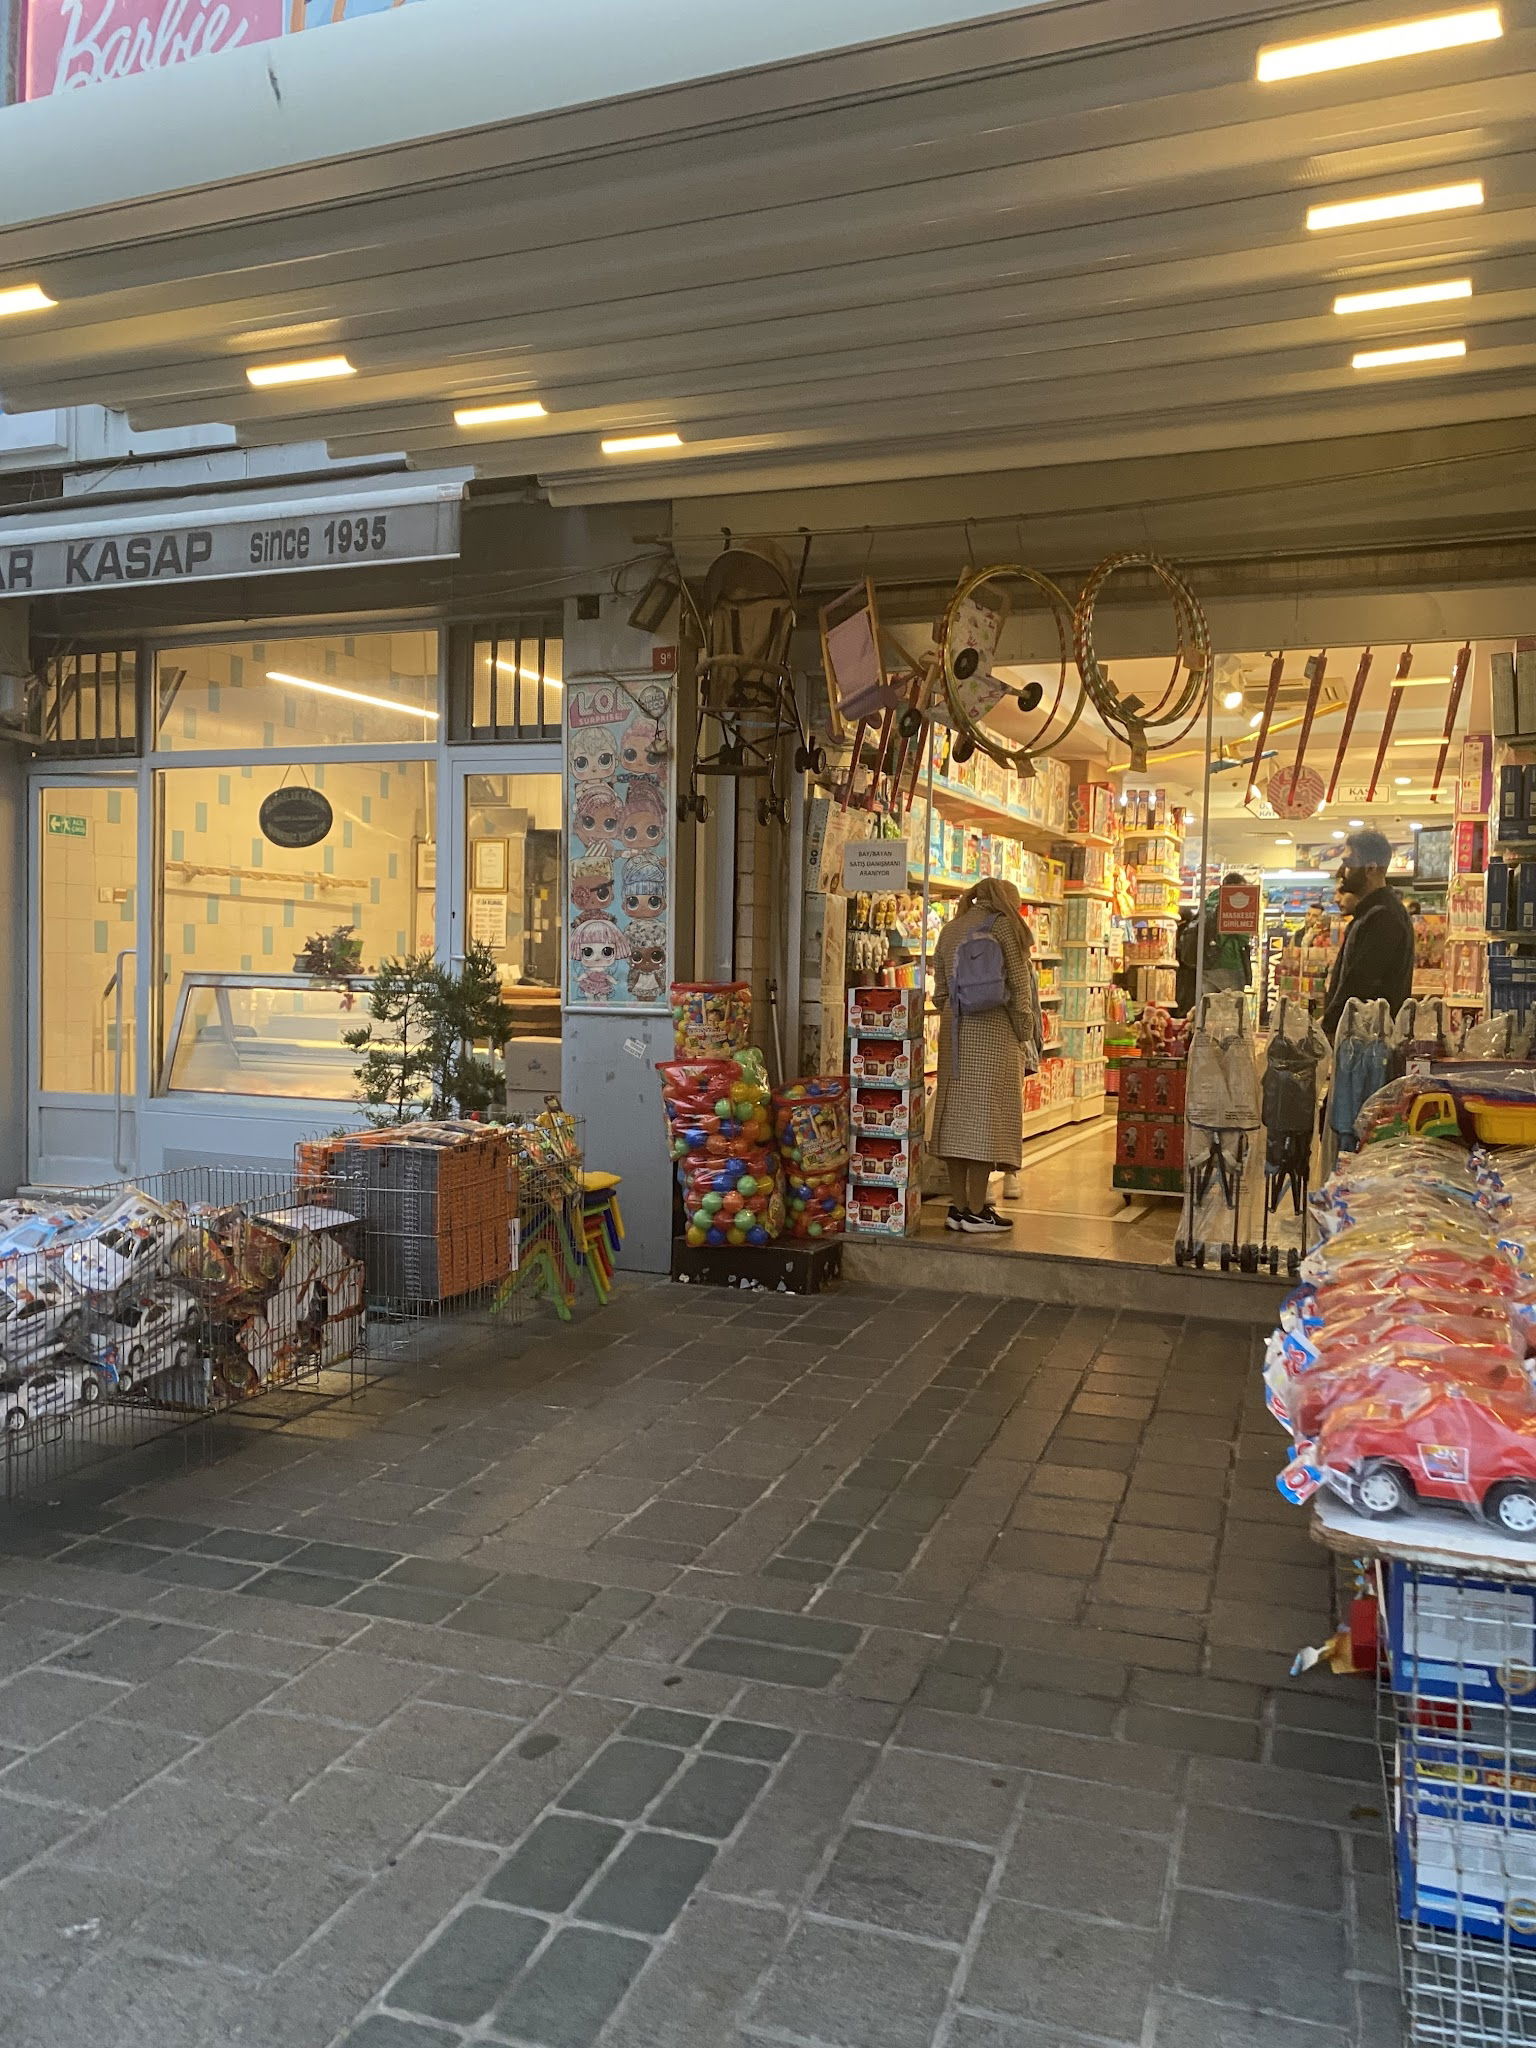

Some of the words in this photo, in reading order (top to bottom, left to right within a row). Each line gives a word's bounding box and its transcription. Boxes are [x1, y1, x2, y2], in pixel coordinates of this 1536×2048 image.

[52, 0, 248, 96] Barbie
[66, 533, 212, 584] KASAP
[250, 526, 310, 564] since
[323, 515, 387, 555] 1935
[1267, 952, 1283, 1013] VARTA
